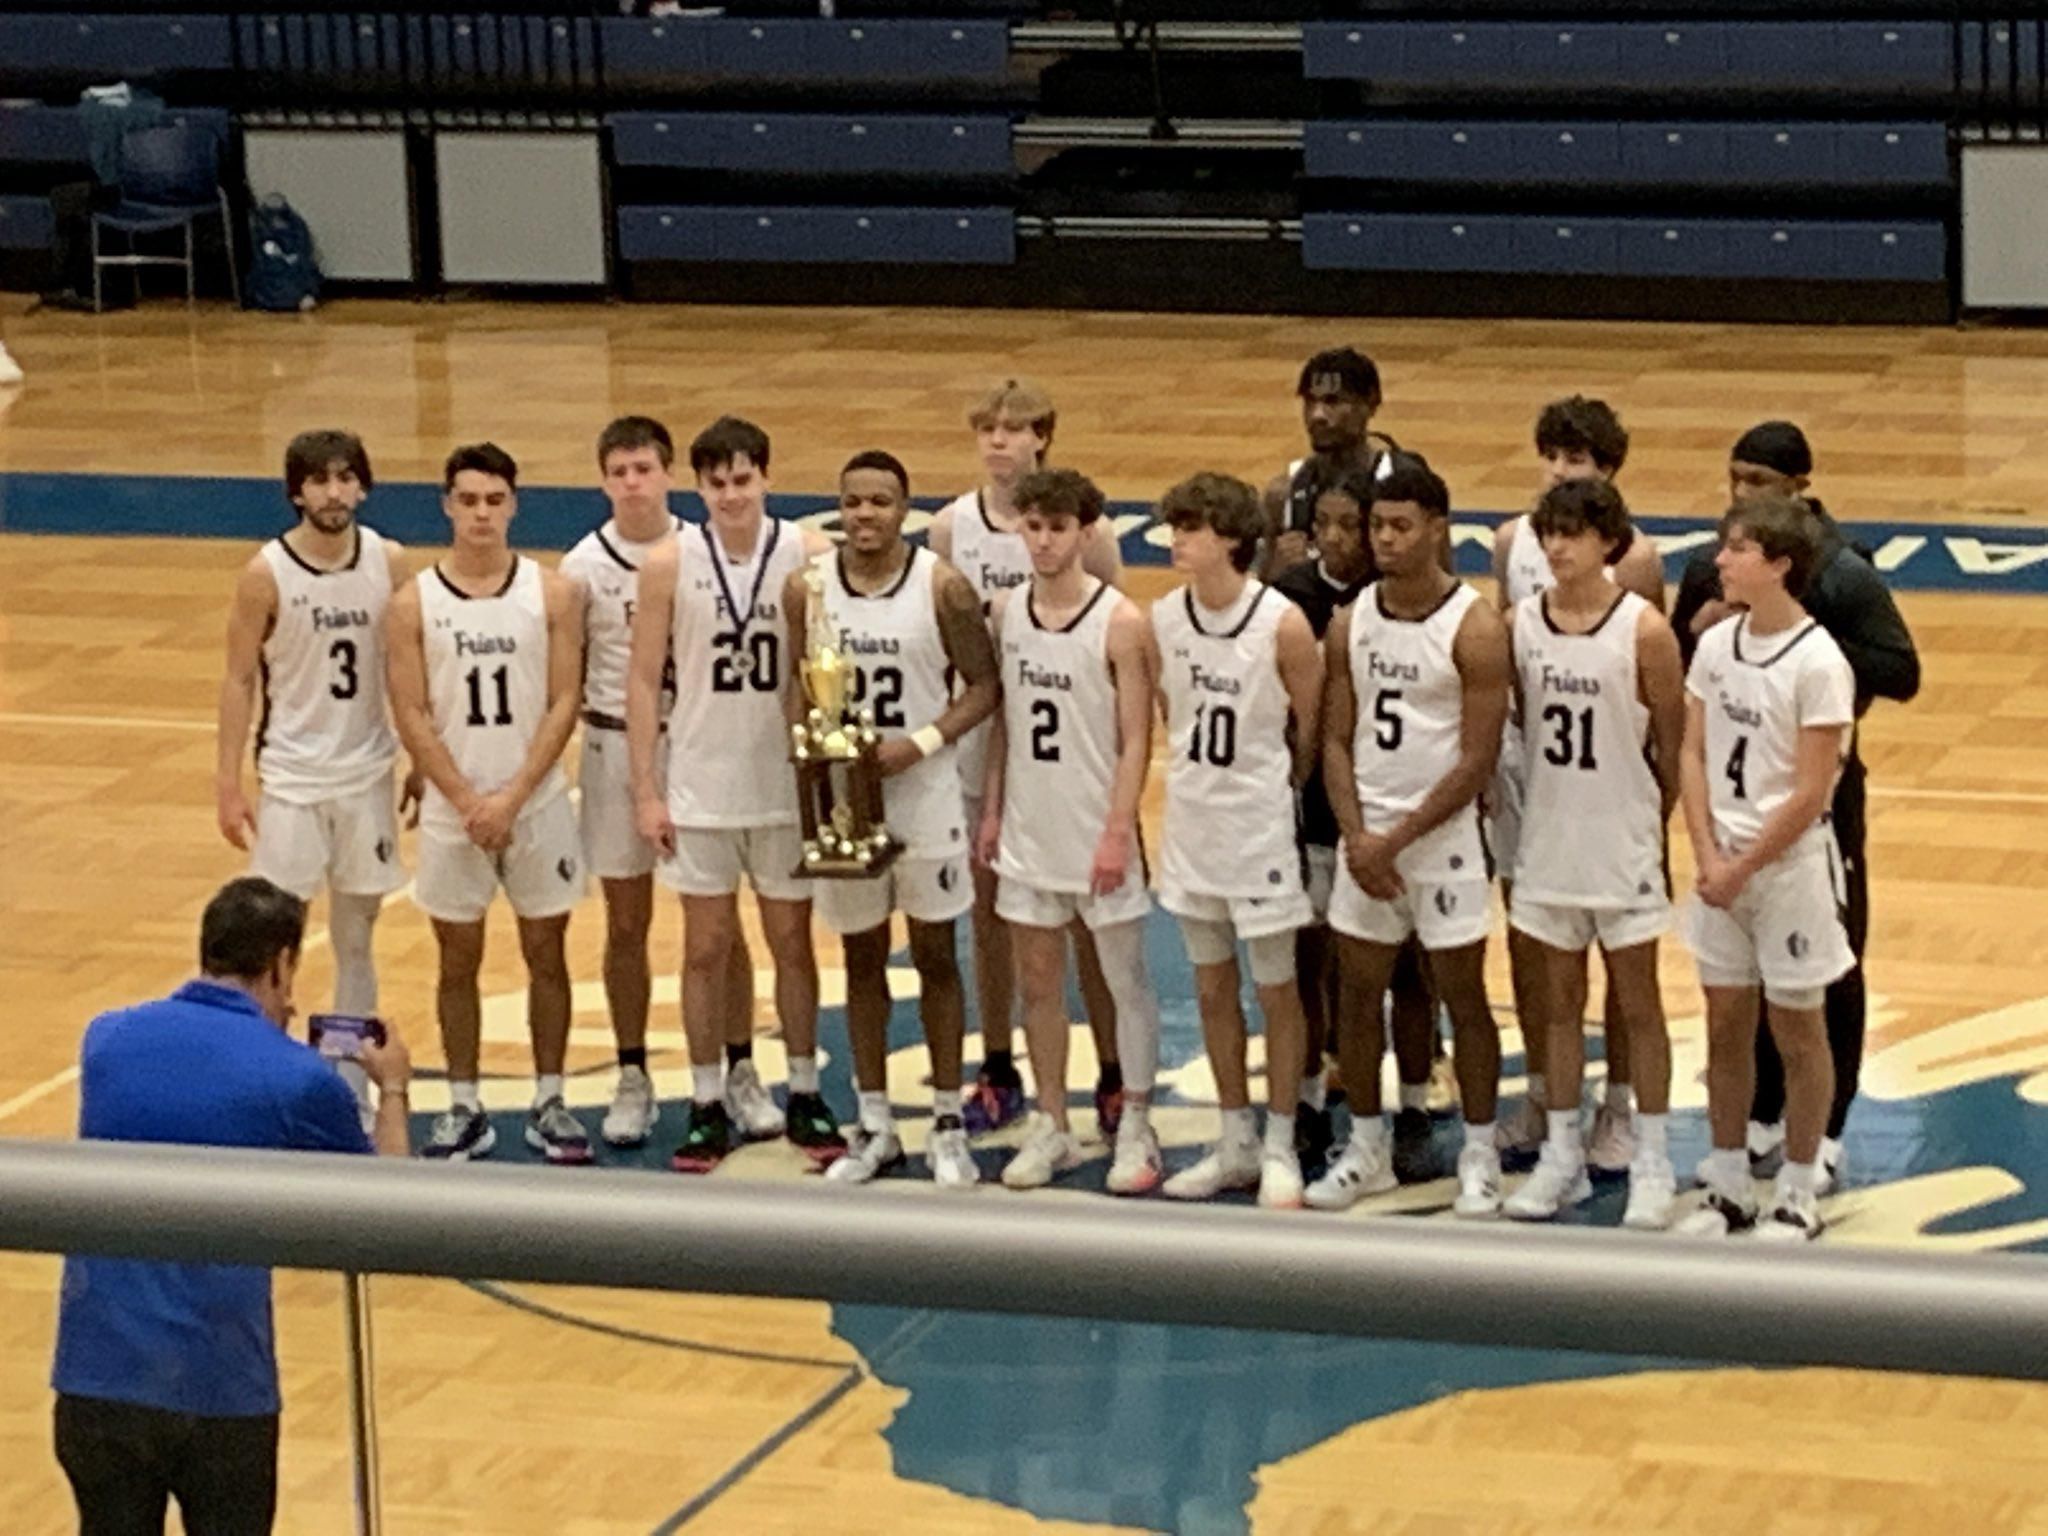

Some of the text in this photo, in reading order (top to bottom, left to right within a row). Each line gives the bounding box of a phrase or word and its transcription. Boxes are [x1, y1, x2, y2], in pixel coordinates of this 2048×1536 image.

[312, 606, 369, 631] Friars
[454, 631, 516, 656] Friars
[838, 629, 900, 655] Friars
[329, 640, 358, 699] 3
[712, 632, 778, 692] 20
[1019, 660, 1072, 691] Friars
[1541, 665, 1600, 696] Friars
[466, 665, 513, 726] 11
[1375, 690, 1403, 750] 5
[1032, 700, 1060, 761] 2
[1187, 701, 1235, 767] 10
[1543, 704, 1597, 770] 31
[1726, 736, 1748, 798] 4
